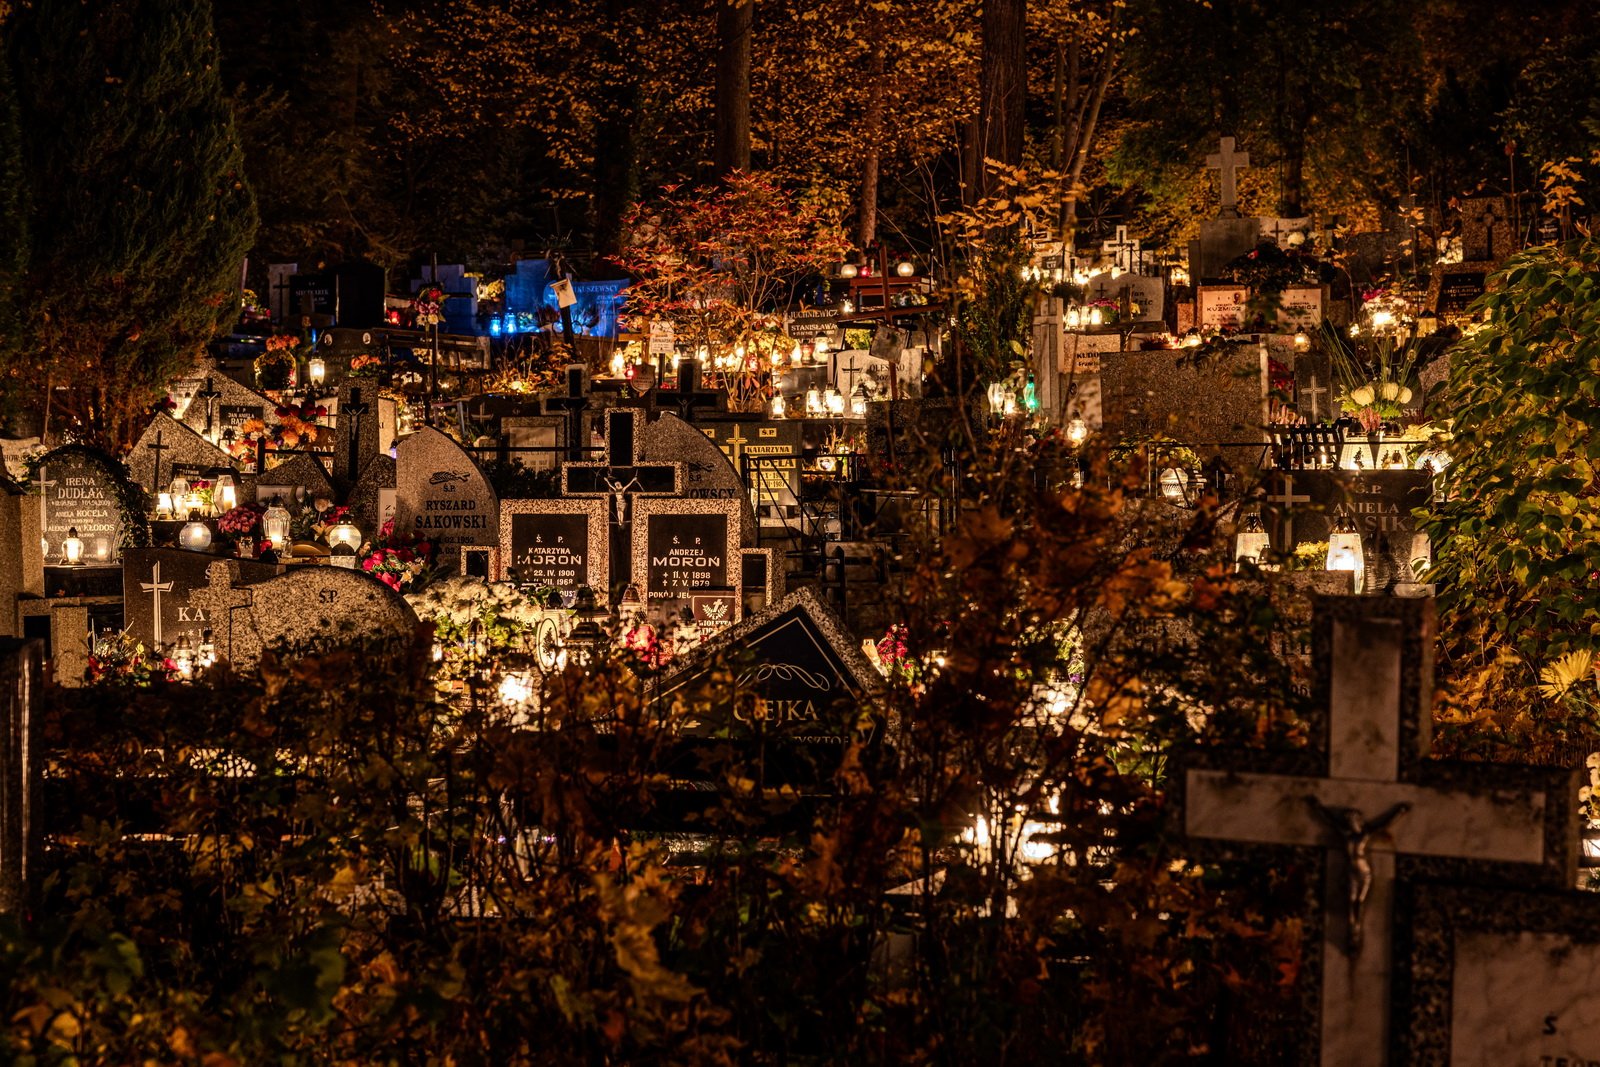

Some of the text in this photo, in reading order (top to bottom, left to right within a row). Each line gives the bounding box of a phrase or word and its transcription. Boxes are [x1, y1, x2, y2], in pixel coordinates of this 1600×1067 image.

[869, 363, 906, 371] OLESKO
[65, 477, 96, 486] IRENA
[57, 487, 105, 499] DUDŁAK
[688, 488, 736, 499] OWSCY
[425, 500, 476, 510] RYSZARD
[1332, 502, 1400, 514] ANIELA
[76, 509, 109, 518] KOCELA
[415, 515, 487, 528] SAKOWSKI
[528, 547, 571, 555] KATARZYNA
[517, 554, 582, 565] MOROŃ
[652, 556, 720, 567] MOROŃ
[558, 569, 575, 577] 1900
[692, 571, 711, 579] 1898
[319, 587, 339, 604] Ś.P.
[648, 590, 674, 598] POKÓJ
[177, 607, 212, 622] KA
[732, 699, 822, 727] CEJKA
